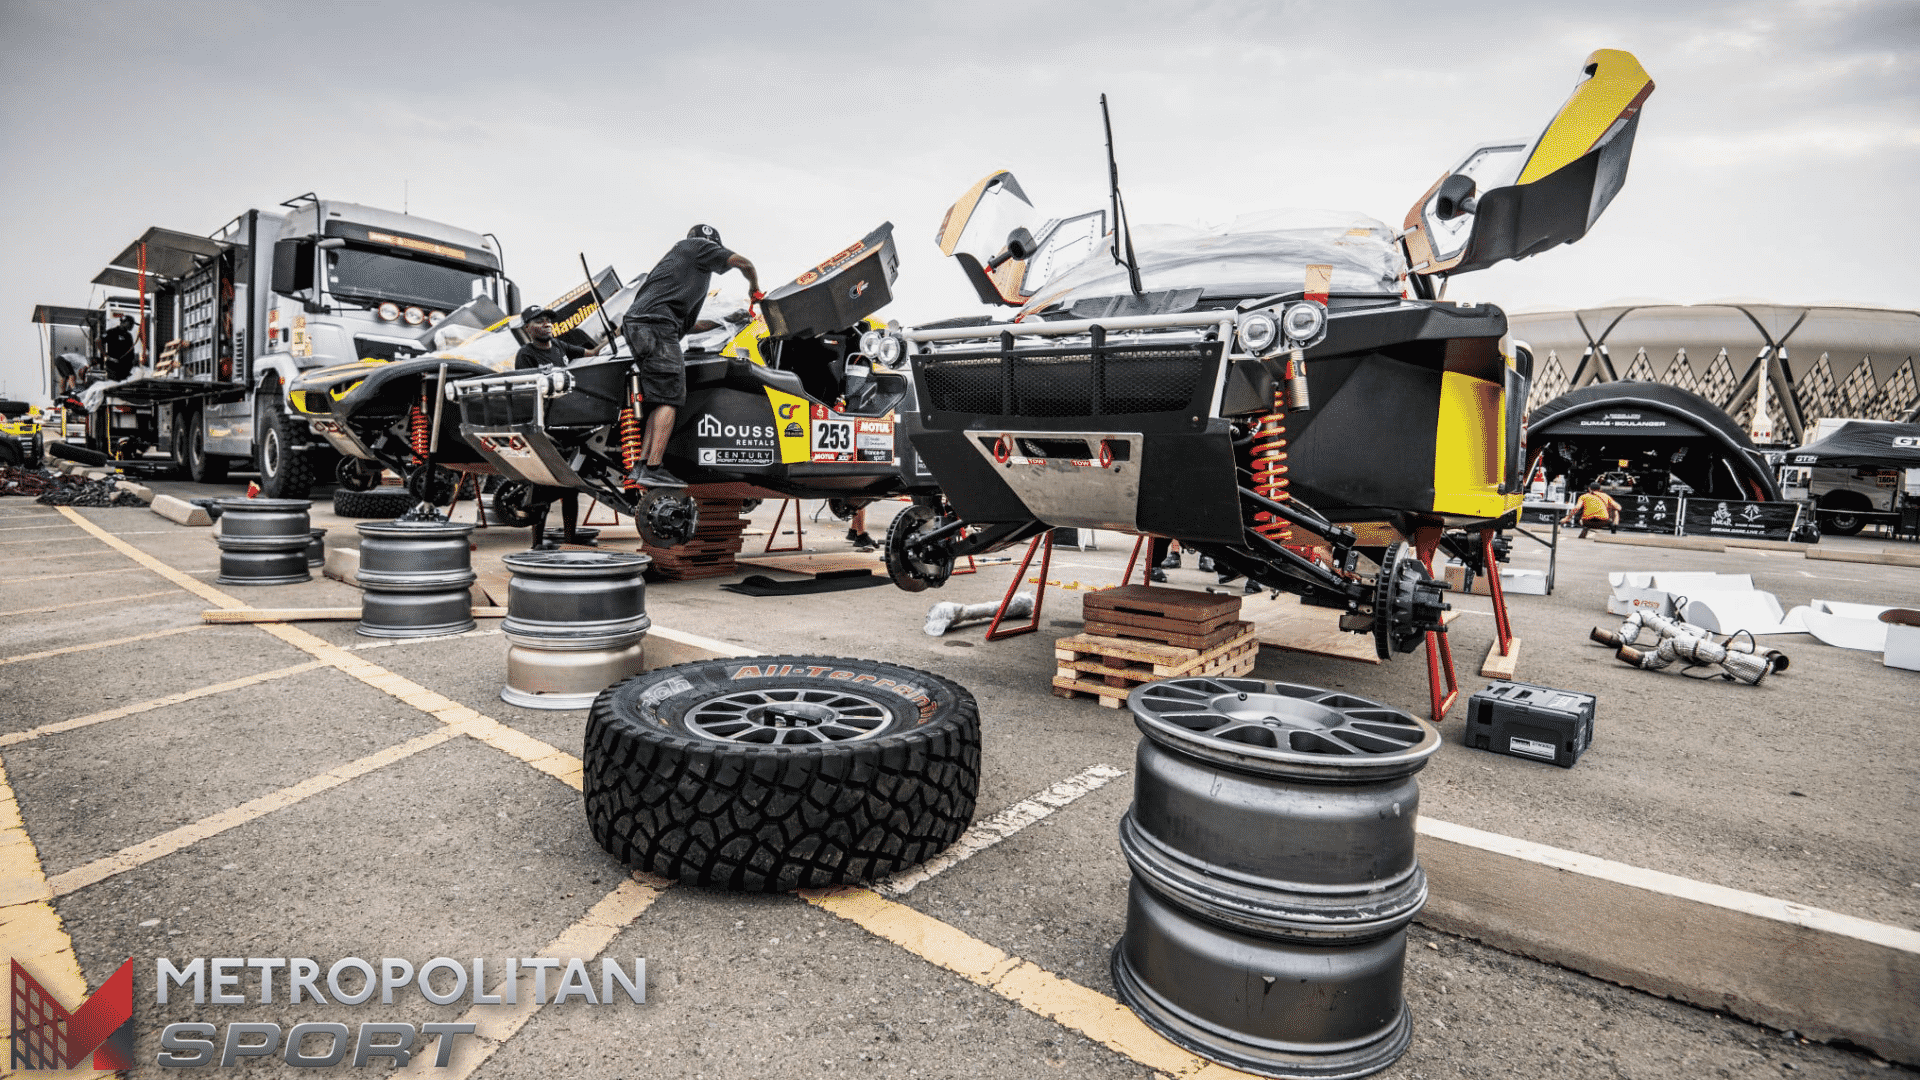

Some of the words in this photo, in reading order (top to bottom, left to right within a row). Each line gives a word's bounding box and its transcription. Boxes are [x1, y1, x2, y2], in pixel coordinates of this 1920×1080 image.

[550, 302, 600, 338] Havolin
[817, 422, 851, 450] 253
[860, 421, 891, 433] MOTUL
[735, 439, 775, 447] RENTALS
[716, 451, 771, 459] CENTURY
[731, 664, 934, 710] All-Terrain
